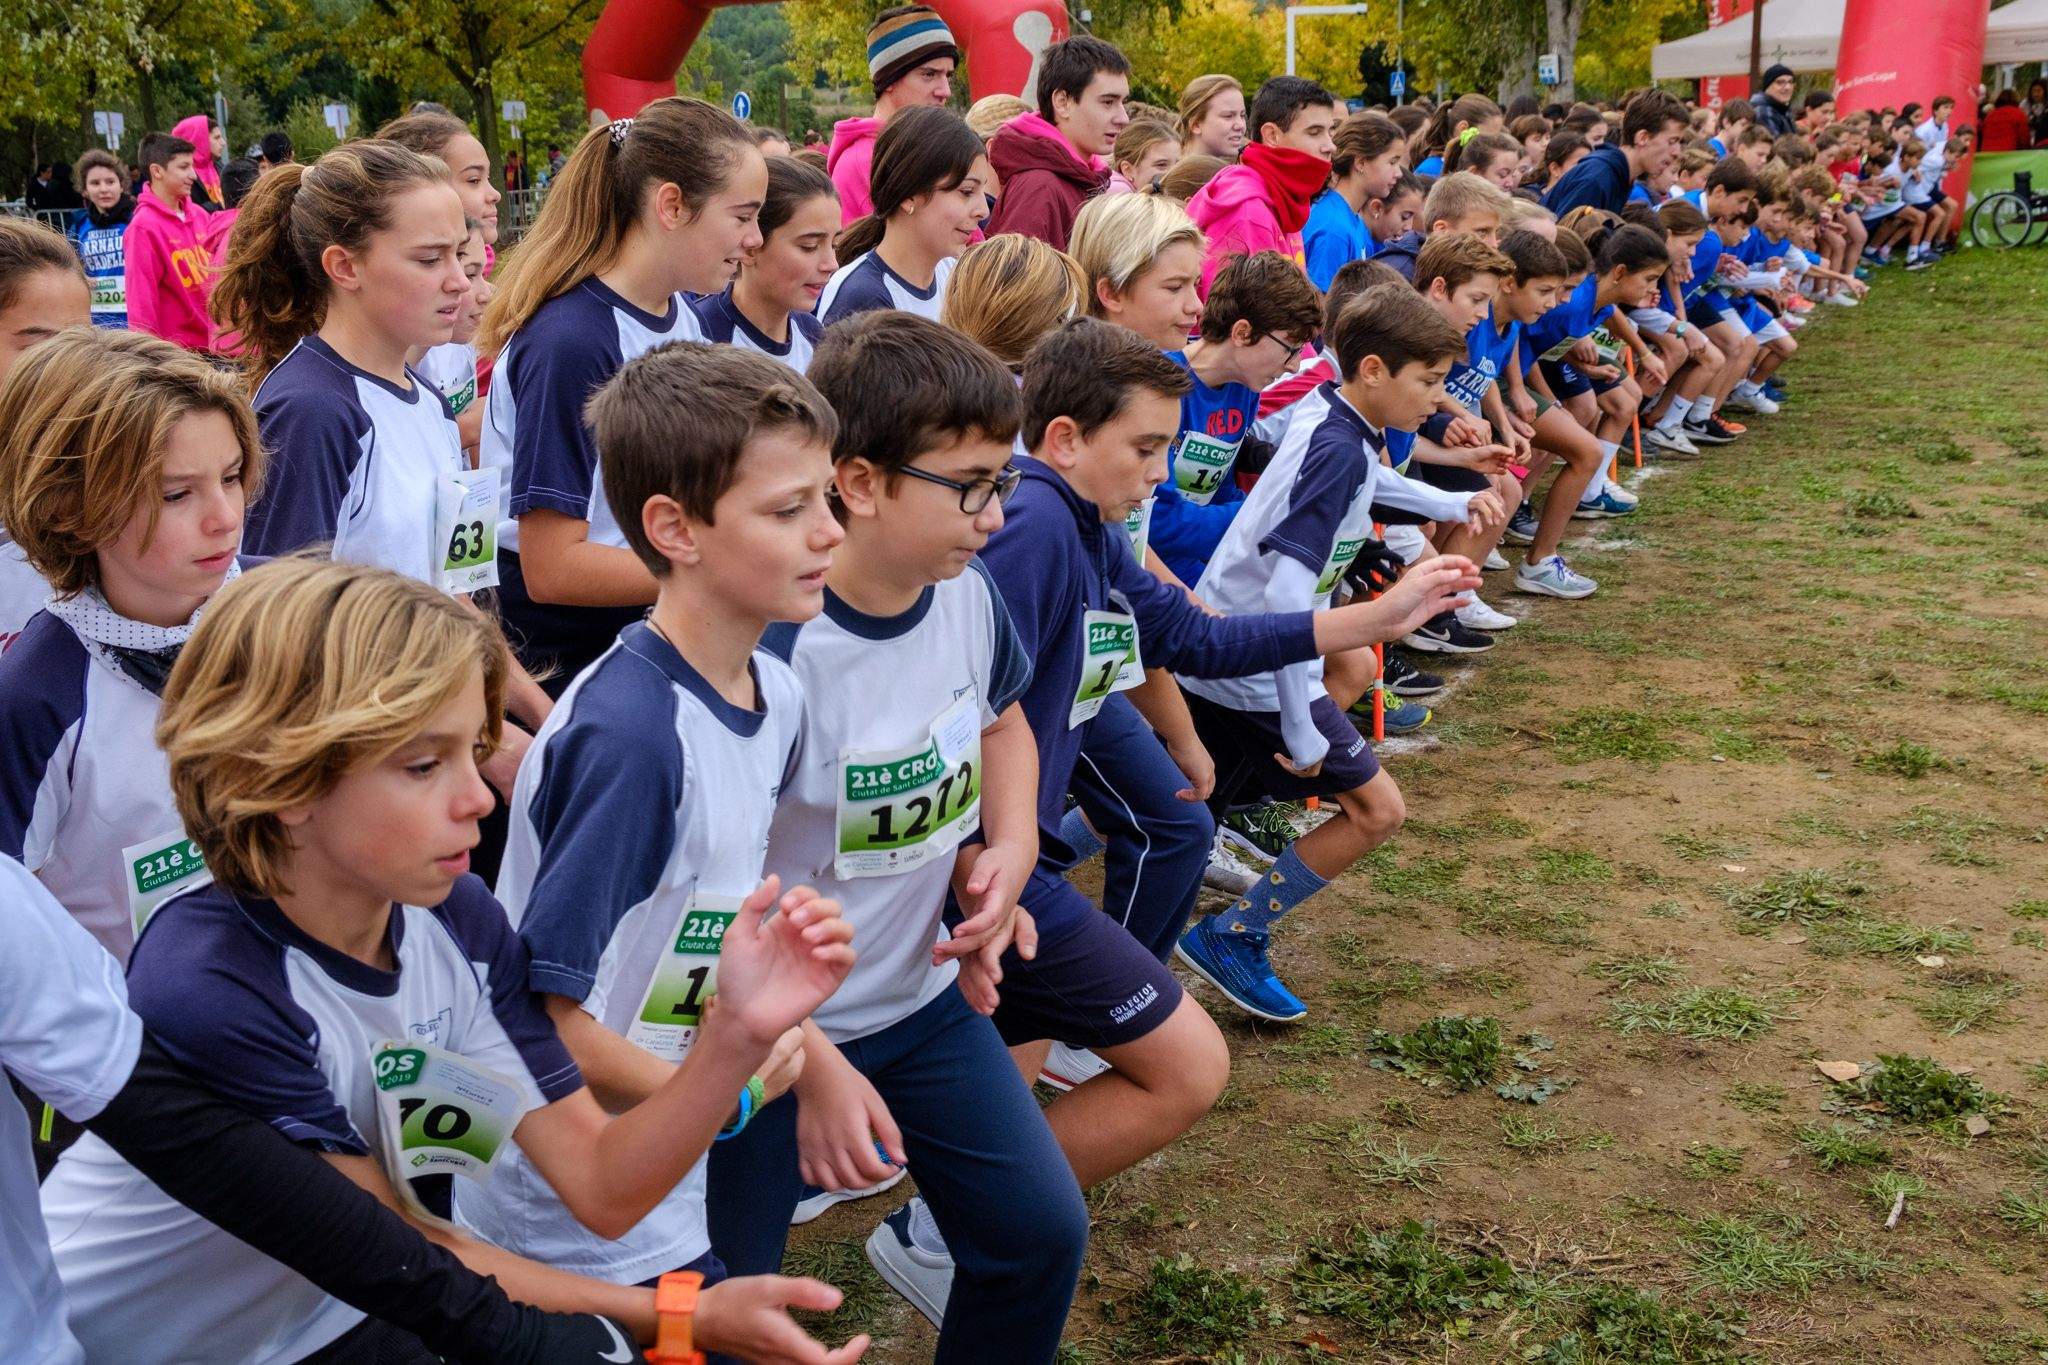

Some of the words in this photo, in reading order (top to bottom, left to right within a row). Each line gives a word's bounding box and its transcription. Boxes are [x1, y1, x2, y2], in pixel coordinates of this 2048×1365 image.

[83, 236, 124, 256] ARNAU
[1206, 408, 1243, 436] RED
[1187, 443, 1209, 456] 21è
[448, 520, 484, 562] 63
[1091, 626, 1118, 643] 21è
[851, 768, 893, 789] 21è
[851, 786, 878, 799] Ciutat
[880, 784, 891, 794] de
[893, 780, 911, 792] Sant
[868, 761, 973, 844] 1272
[140, 849, 183, 880] 21è
[144, 873, 171, 888] Ciutat
[173, 867, 184, 877] de
[684, 917, 724, 939] 21è
[680, 940, 706, 950] Ciutat
[706, 941, 717, 950] de
[1110, 983, 1153, 1017] COLEGIOS
[386, 1074, 412, 1085] 2019
